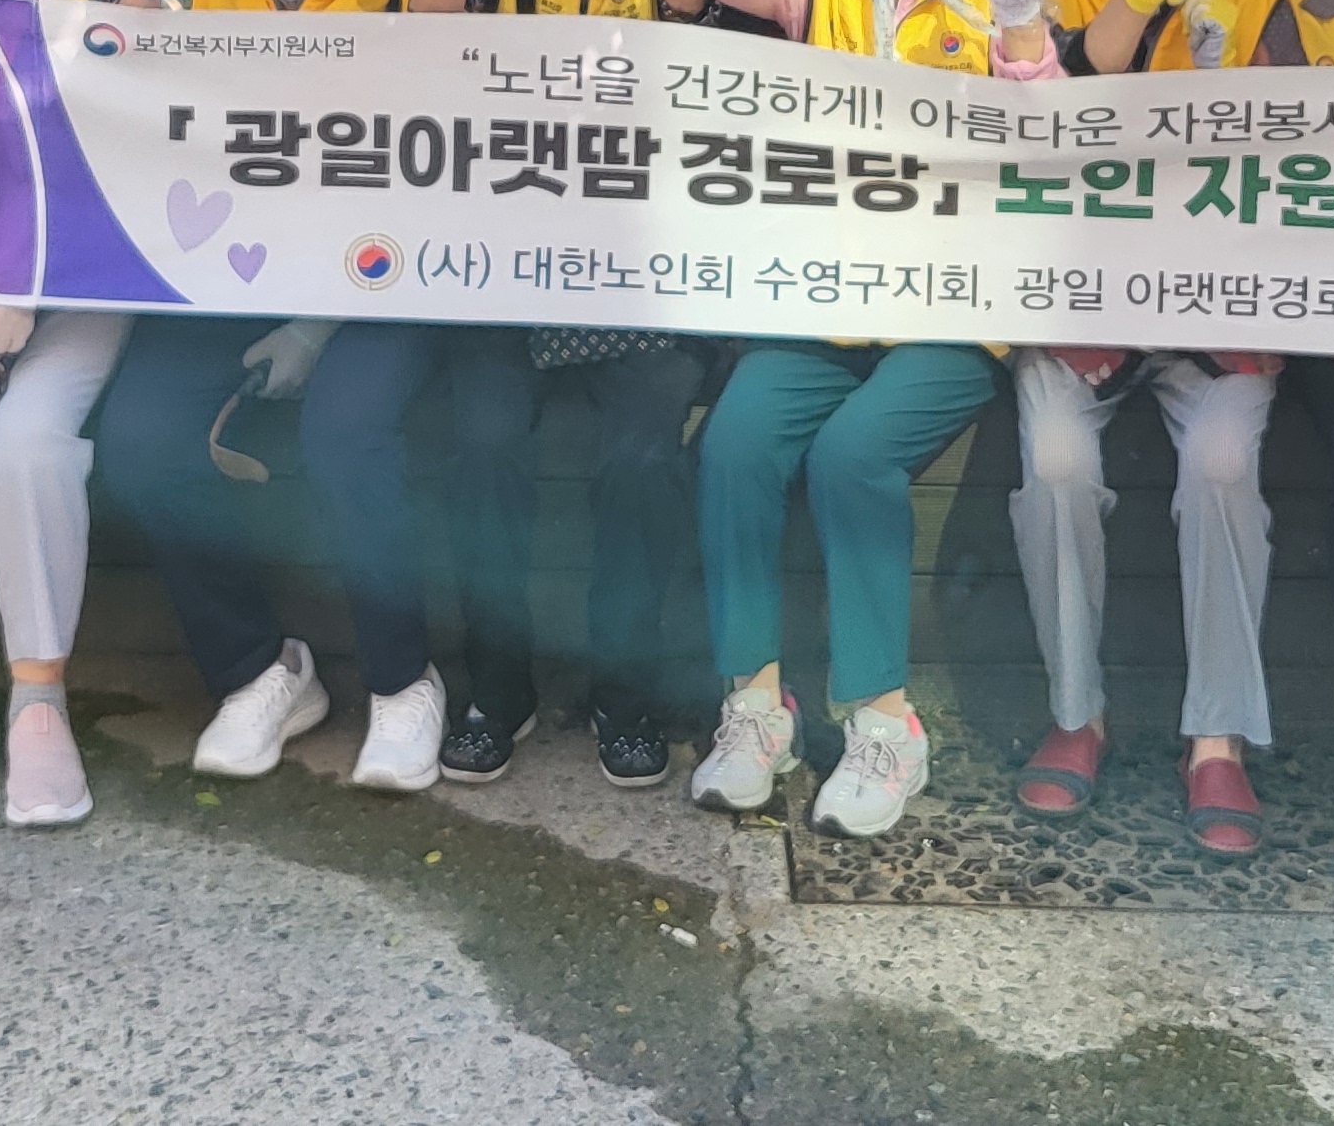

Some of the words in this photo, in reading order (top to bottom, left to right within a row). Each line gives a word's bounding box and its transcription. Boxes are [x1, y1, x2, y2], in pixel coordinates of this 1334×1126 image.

[133, 33, 356, 59] 보건복지부지원사업
[663, 64, 884, 131] 건강하게!
[909, 98, 1124, 149] 아름다운
[995, 157, 1156, 220] 노인
[417, 239, 492, 290] (사)
[513, 246, 734, 299] 대한노인회
[753, 256, 993, 310] 수영구지회,
[1014, 266, 1104, 313] 광일
